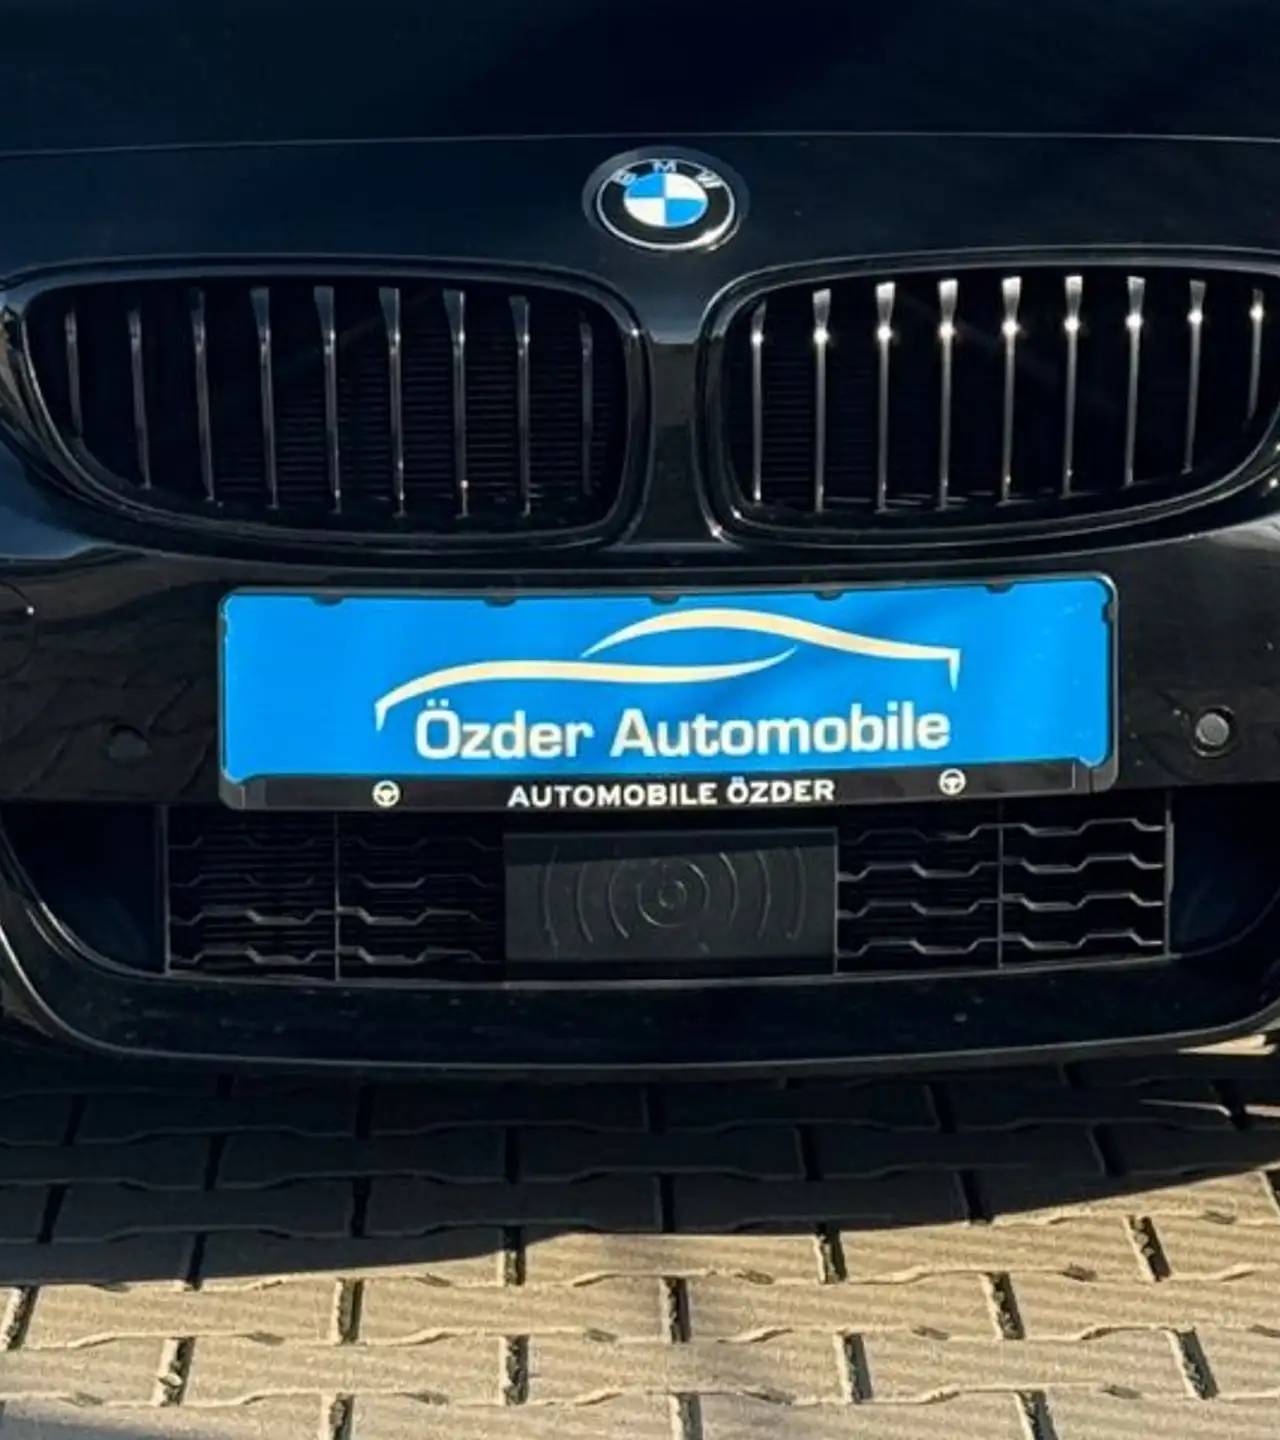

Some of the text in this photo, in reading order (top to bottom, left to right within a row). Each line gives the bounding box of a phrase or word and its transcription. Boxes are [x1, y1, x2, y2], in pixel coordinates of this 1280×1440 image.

[609, 160, 723, 188] BMW
[416, 698, 951, 760] Özder Automobile
[508, 776, 835, 808] AUTOMOBILE ÖZDER
